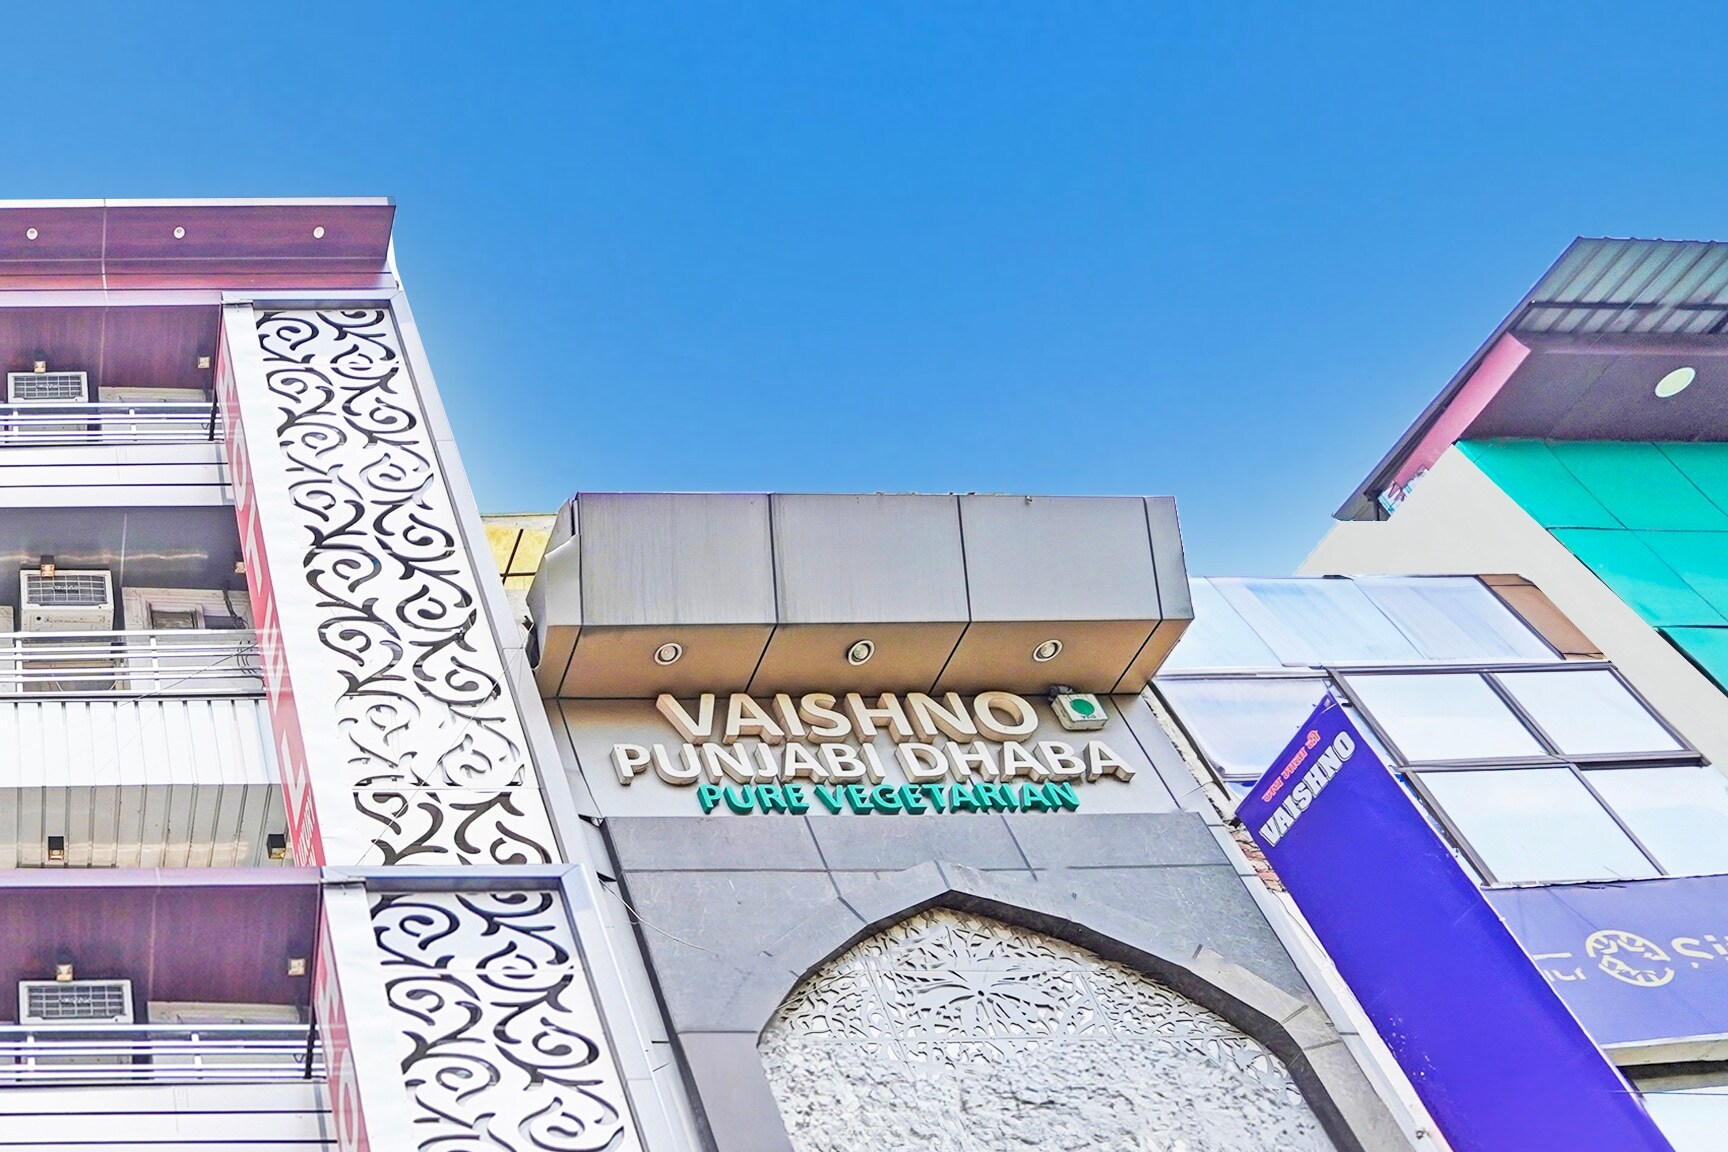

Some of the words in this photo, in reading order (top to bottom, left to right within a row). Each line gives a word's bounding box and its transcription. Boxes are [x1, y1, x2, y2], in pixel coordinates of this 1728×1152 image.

[656, 691, 1039, 744] VAISHNO
[610, 742, 885, 787] PUNJABI
[894, 741, 1136, 783] DHABA
[697, 784, 810, 815] PURE
[814, 782, 1080, 815] VEGETARIAN
[1258, 731, 1355, 847] VAISHNO
